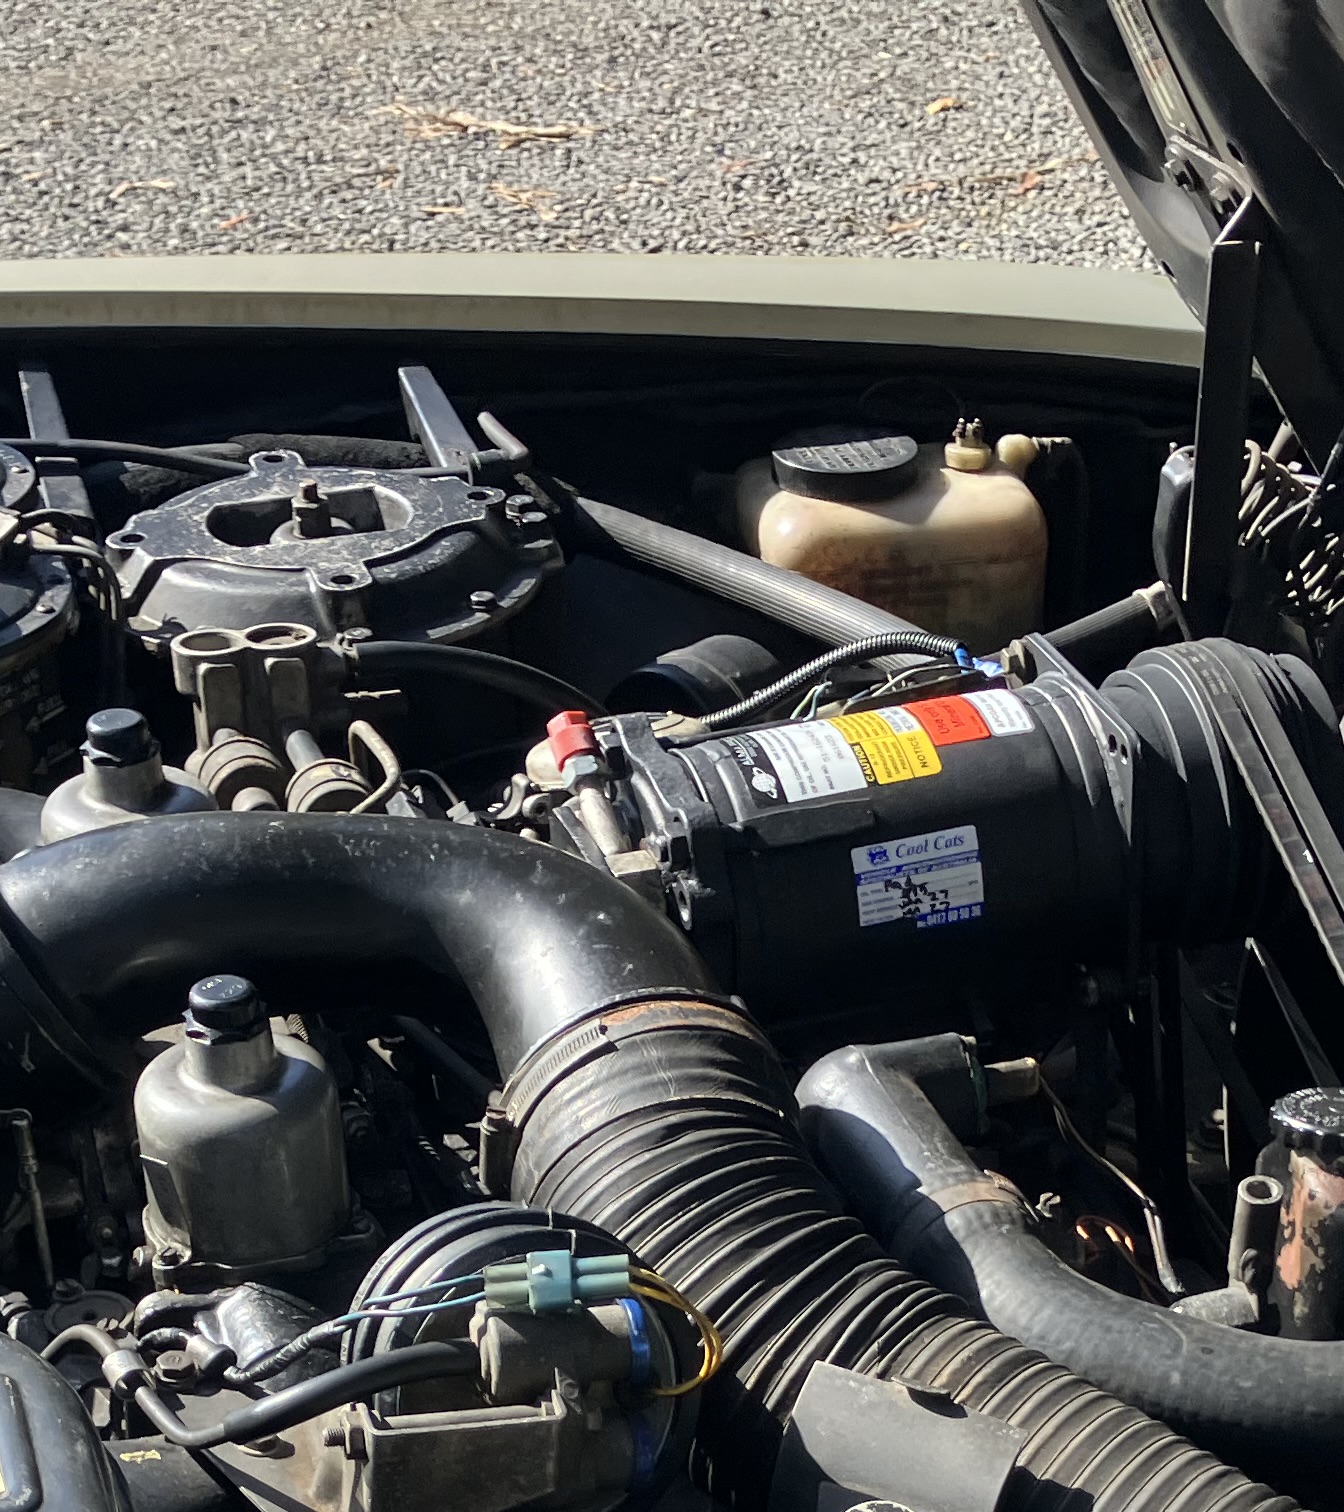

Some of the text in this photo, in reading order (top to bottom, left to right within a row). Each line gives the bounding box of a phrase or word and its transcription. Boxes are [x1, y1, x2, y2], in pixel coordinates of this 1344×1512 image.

[934, 719, 950, 734] Use
[852, 745, 875, 782] CAUTION
[907, 736, 929, 768] NOTICE
[896, 835, 964, 858] Cool Cats
